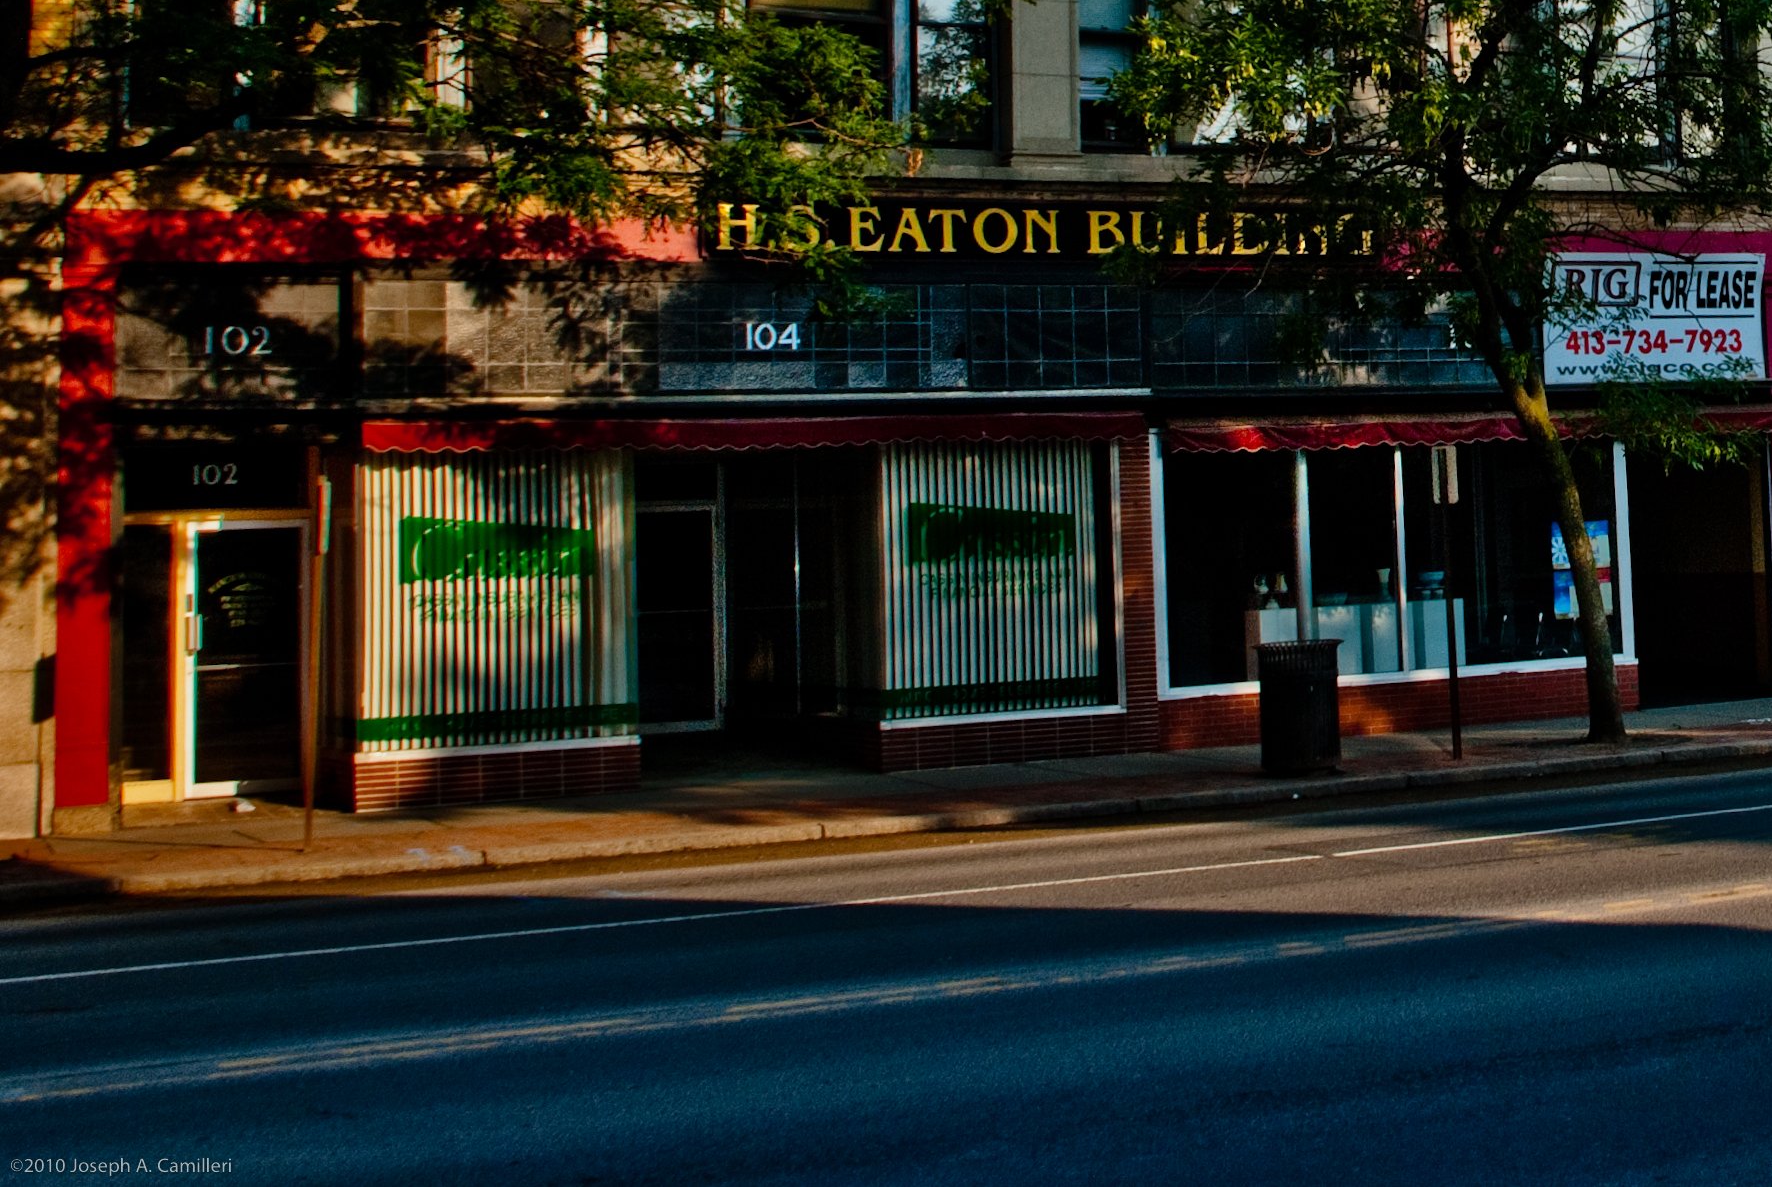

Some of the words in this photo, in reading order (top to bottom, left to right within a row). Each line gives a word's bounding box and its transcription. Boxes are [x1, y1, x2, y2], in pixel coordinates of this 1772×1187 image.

[847, 207, 1062, 254] EATON
[1650, 270, 1688, 310] FOR
[1697, 270, 1757, 309] LEASE
[204, 325, 273, 355] 102
[746, 322, 800, 351] 104
[1566, 328, 1743, 356] 413-734-7923
[193, 463, 239, 486] 102
